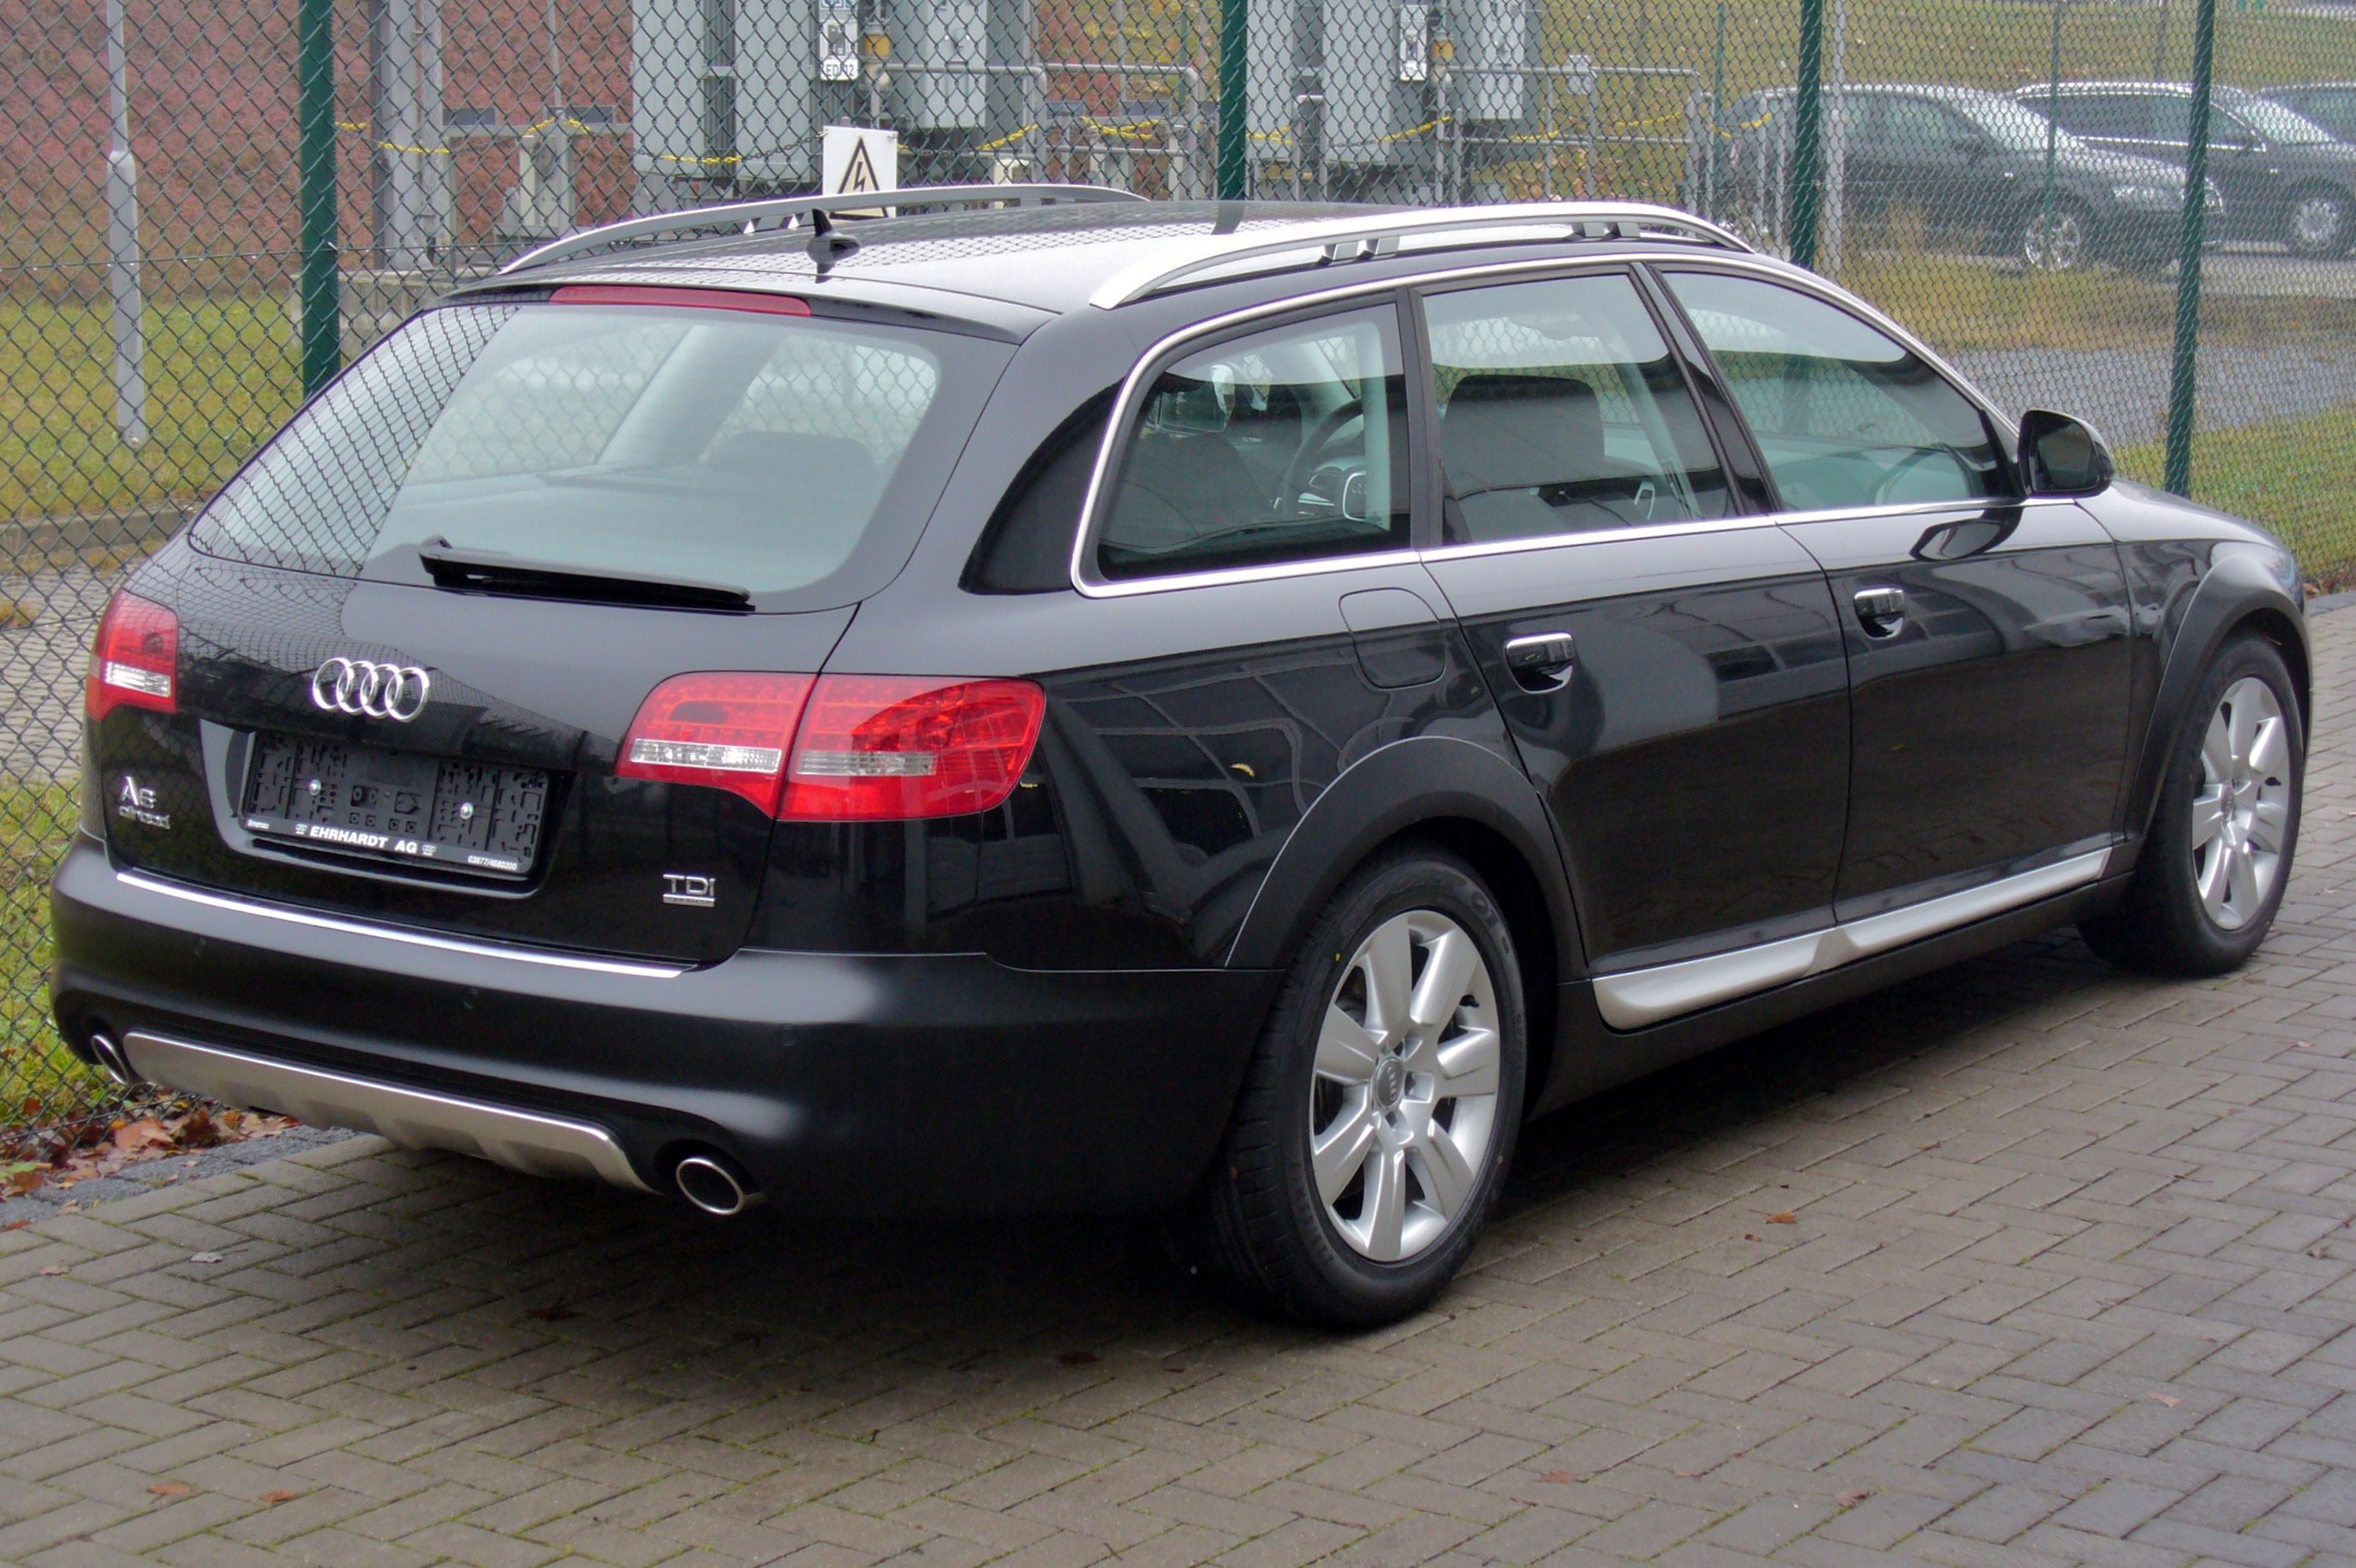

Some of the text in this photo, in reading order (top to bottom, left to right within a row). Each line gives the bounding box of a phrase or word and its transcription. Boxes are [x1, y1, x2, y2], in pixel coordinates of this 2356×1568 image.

[120, 775, 157, 809] A6
[309, 826, 418, 855] EHRHARDT AG
[662, 873, 716, 897] TDI
